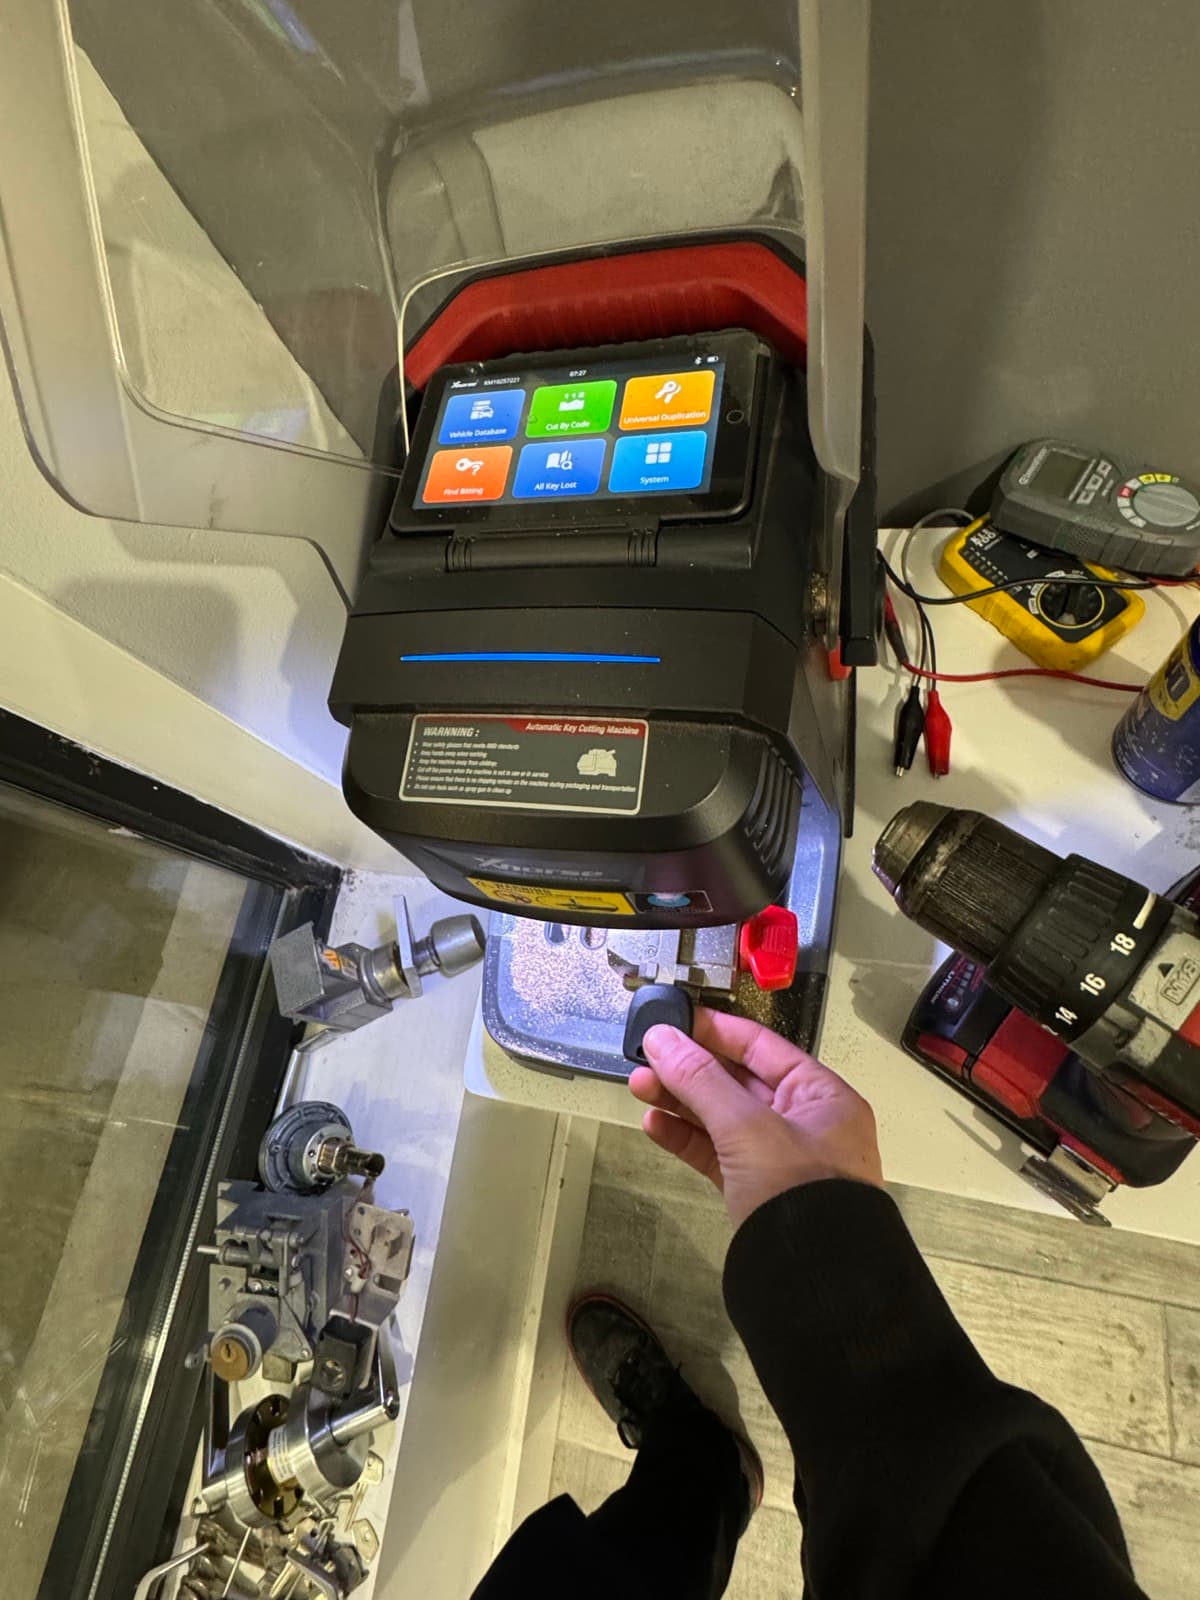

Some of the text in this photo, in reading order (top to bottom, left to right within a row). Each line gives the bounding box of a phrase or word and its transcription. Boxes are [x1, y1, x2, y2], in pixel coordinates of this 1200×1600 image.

[624, 410, 706, 424] Universal Duplication
[560, 423, 570, 431] By
[570, 420, 590, 429] Code
[450, 428, 507, 439] Vehicle Database
[546, 482, 560, 492] Key
[560, 481, 577, 490] Lost
[640, 476, 669, 486] System
[443, 488, 459, 496] Find
[525, 722, 640, 735] Automatic Key Cutting Machine
[1110, 932, 1137, 957] 18
[1079, 972, 1107, 997] 16
[1164, 957, 1199, 1003] M18
[1054, 1005, 1078, 1026] 14
